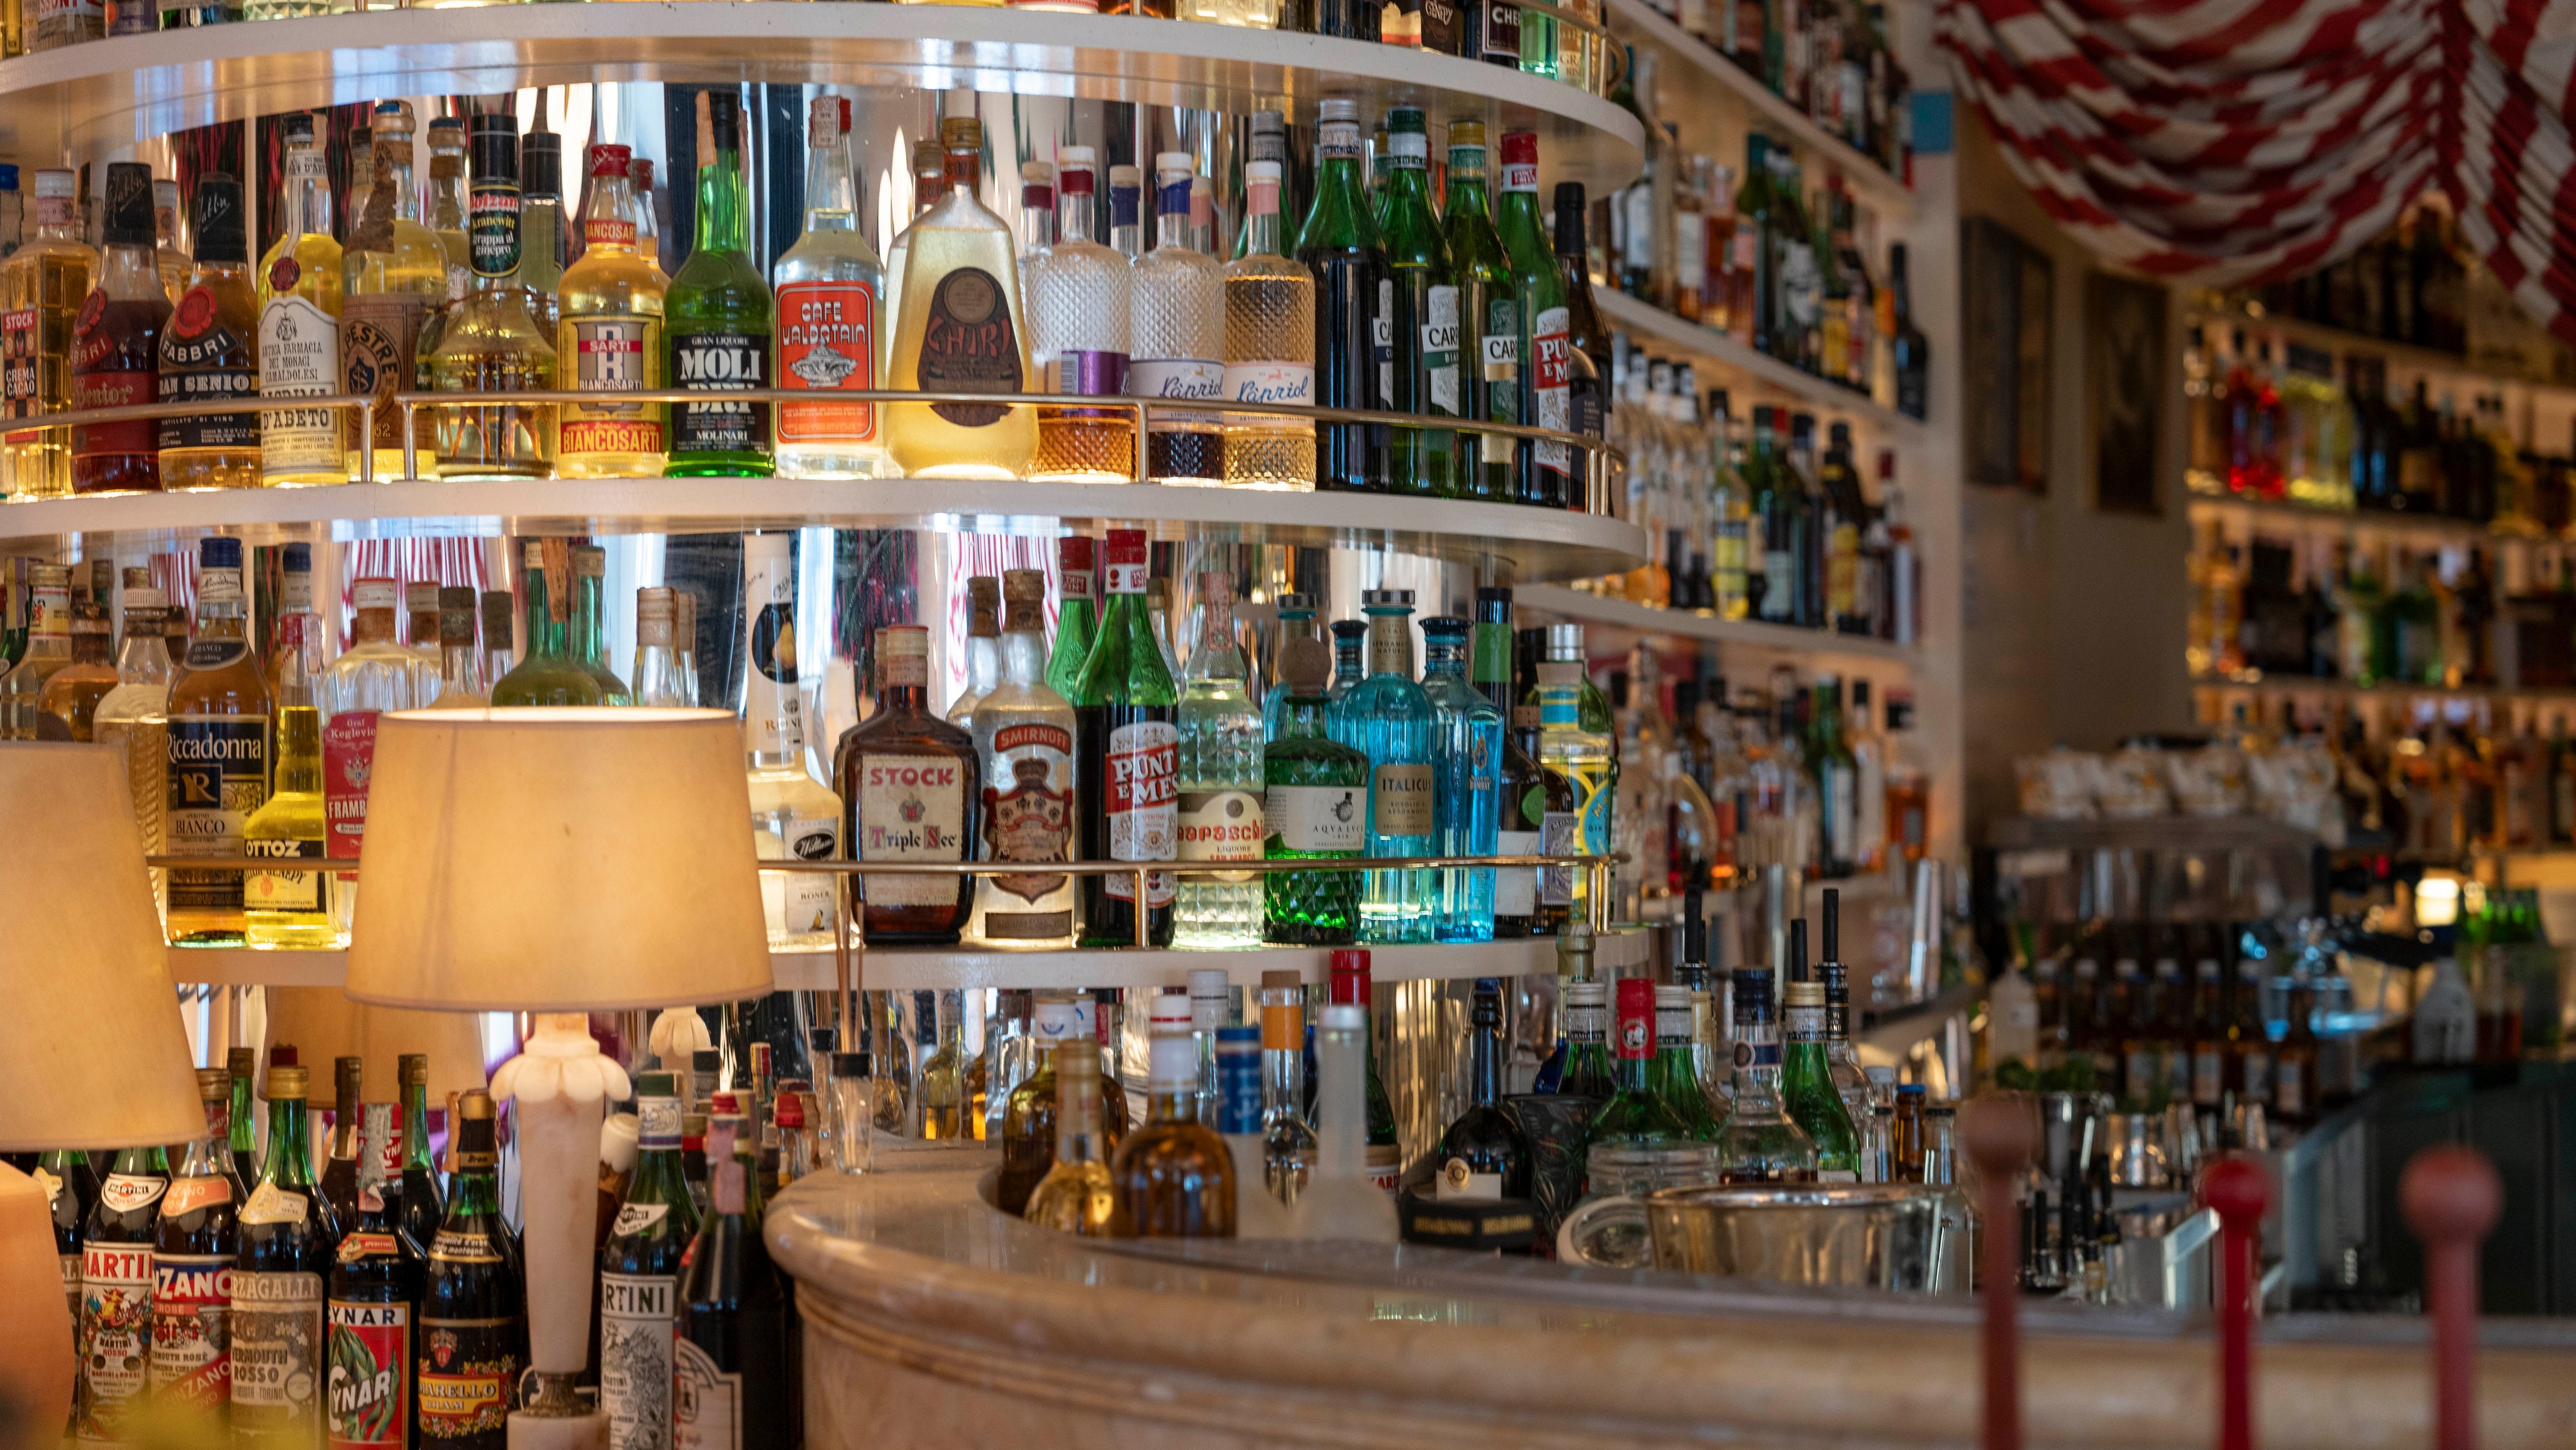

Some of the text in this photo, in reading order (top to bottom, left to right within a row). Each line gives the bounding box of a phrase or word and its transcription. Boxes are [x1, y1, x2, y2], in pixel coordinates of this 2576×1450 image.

[472, 230, 514, 246] grappa al
[475, 244, 511, 257] ginepro
[801, 301, 842, 322] CAFE
[6, 312, 33, 330] STOCK
[692, 336, 750, 347] GRAN LIQUORE
[782, 323, 866, 346] VALDOTAIN
[162, 333, 228, 362] FABBRI
[262, 342, 323, 357] ANTICA FARMACIA
[589, 341, 630, 352] SARTI
[269, 356, 310, 369] DEI MONACI
[680, 348, 761, 381] MOLI
[6, 367, 35, 383] CREMA
[265, 370, 318, 384] CAMALDOLESI
[7, 378, 35, 396] CACAO
[263, 409, 329, 430] D'ABETO
[564, 426, 659, 452] BIANCOSARTI
[696, 430, 748, 441] MOLINARI
[347, 718, 365, 728] Graf
[1001, 728, 1069, 750] SMIRNOFF
[167, 731, 262, 764] Riccadonna
[1111, 748, 1175, 784] PUNT
[870, 767, 955, 786] STOCK
[1116, 773, 1178, 807] E MES
[1382, 778, 1431, 793] ITALICUS
[175, 819, 225, 835] BIANCO
[869, 824, 957, 853] Triple Sec
[246, 839, 301, 857] OTTOZ
[1230, 853, 1257, 861] MARCO
[801, 890, 830, 900] RONER
[108, 1183, 150, 1195] MARTINI
[99, 1337, 132, 1349] MARTINI
[234, 1366, 279, 1383] ROSSO
[259, 1386, 283, 1400] TORINO
